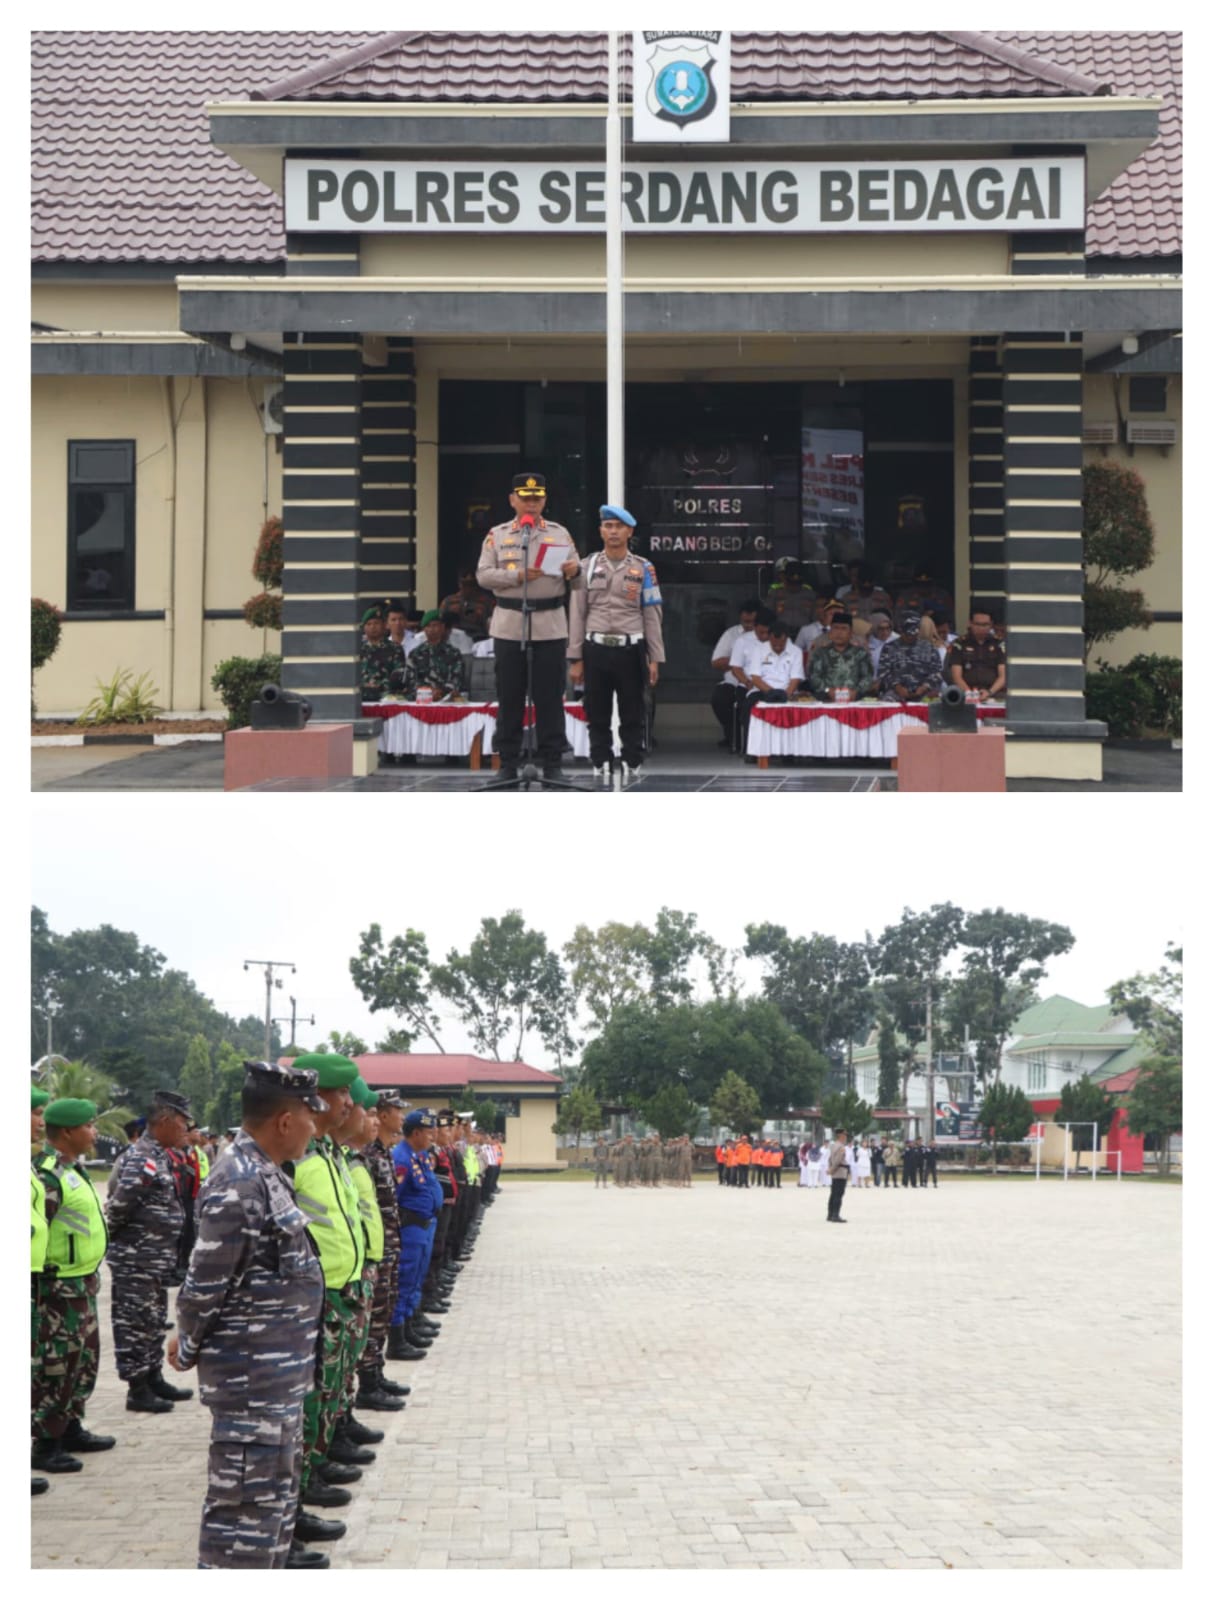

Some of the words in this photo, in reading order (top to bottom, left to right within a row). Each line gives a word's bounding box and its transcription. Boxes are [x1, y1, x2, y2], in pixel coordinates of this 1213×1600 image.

[307, 169, 520, 223] POLRES
[539, 170, 799, 224] SERDANG
[820, 167, 1061, 222] BEDAGAI
[673, 499, 742, 514] POLRES
